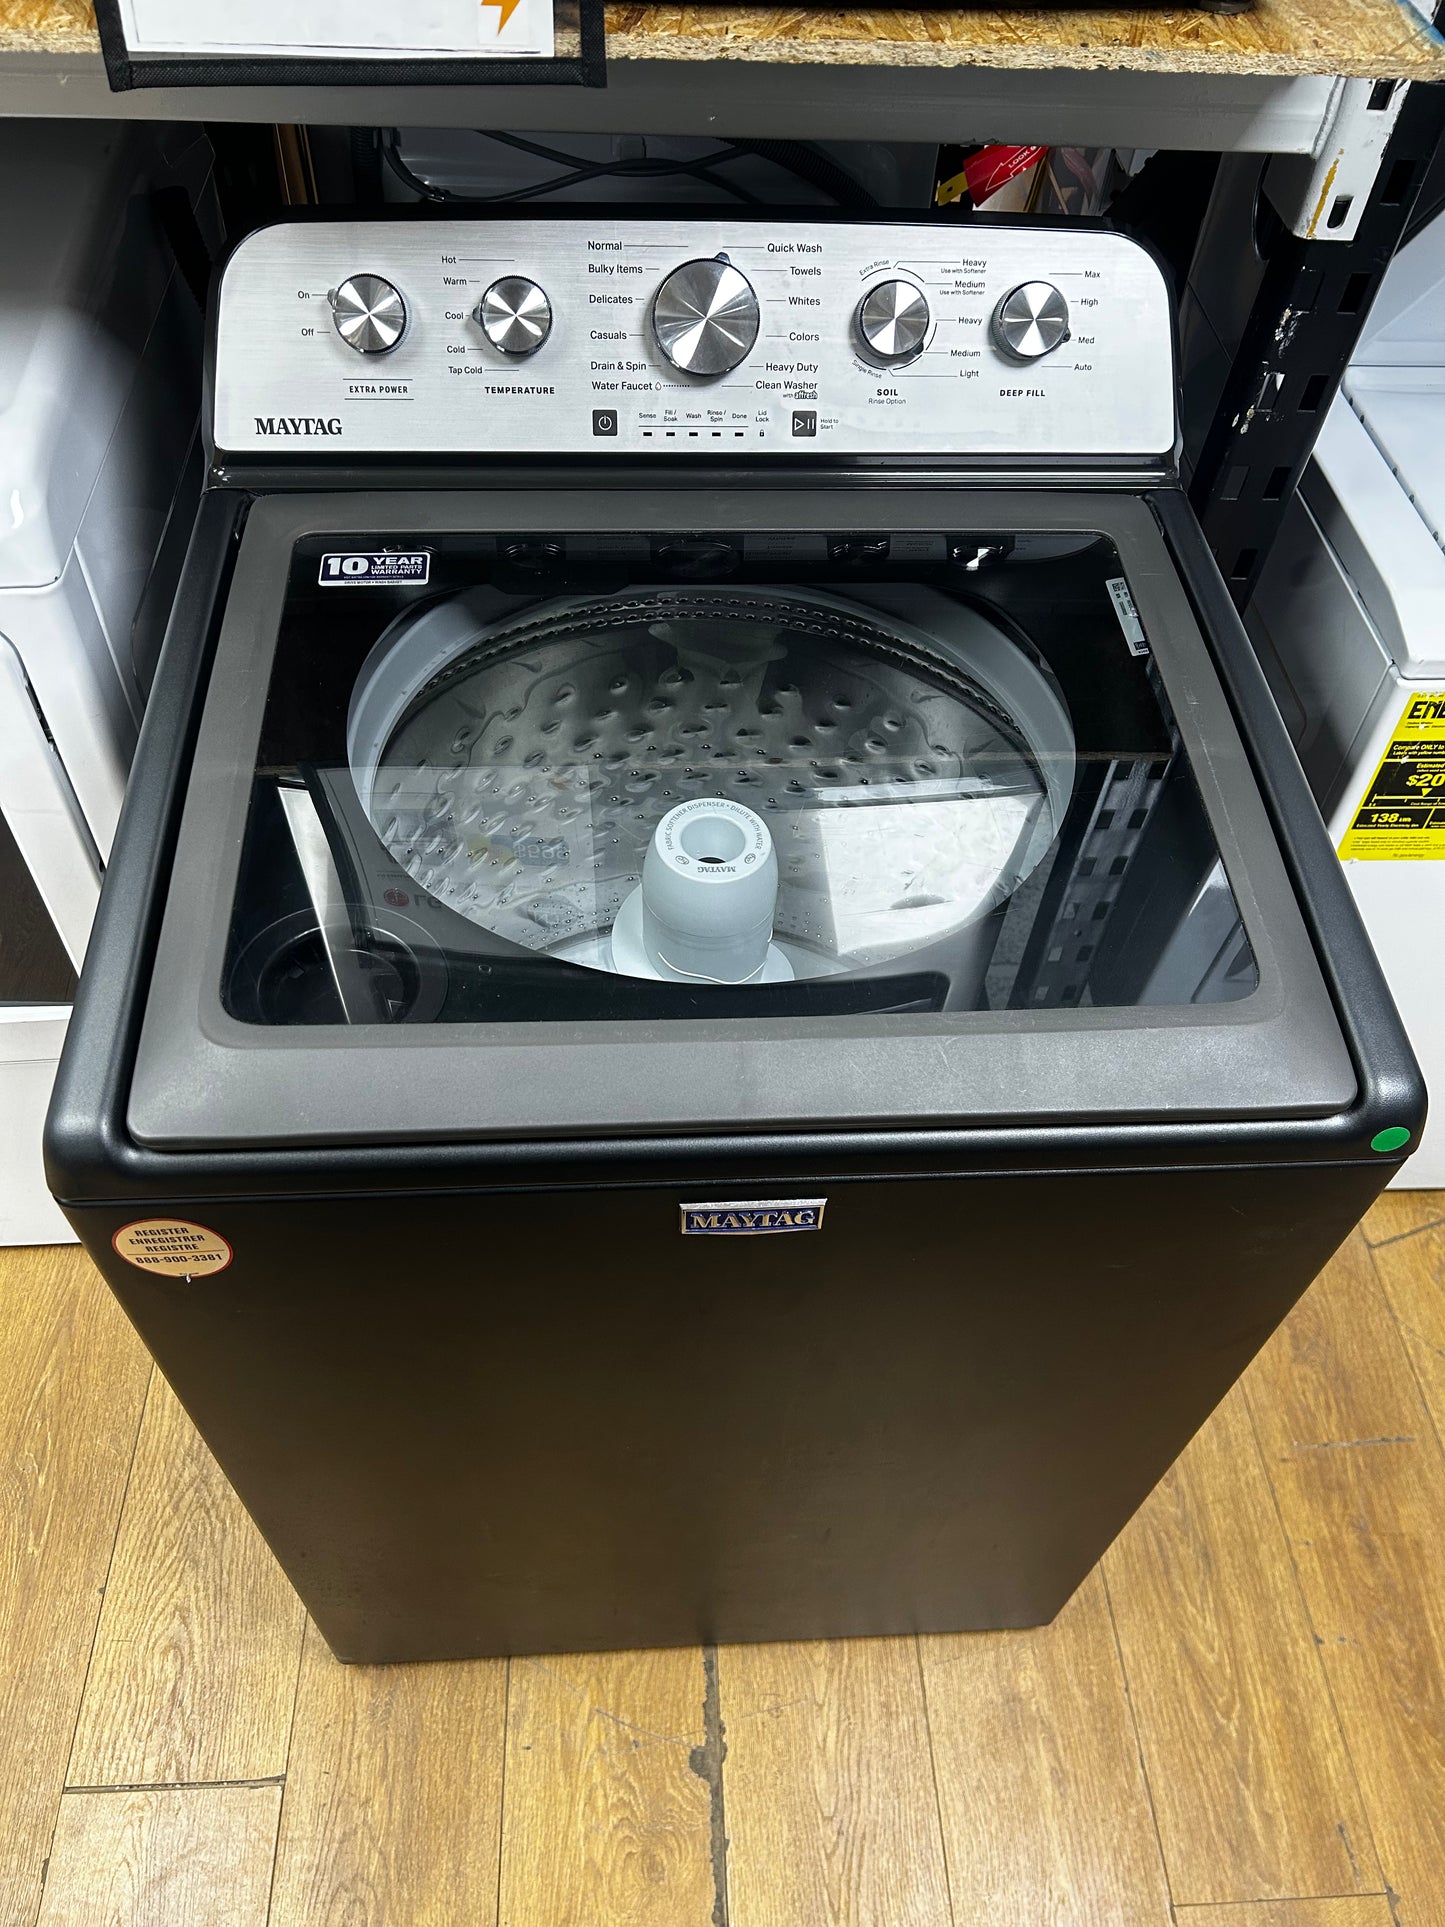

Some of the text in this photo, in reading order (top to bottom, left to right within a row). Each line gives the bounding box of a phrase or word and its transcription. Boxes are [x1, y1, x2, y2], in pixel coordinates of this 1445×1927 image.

[1008, 150, 1030, 168] LOOK
[588, 241, 622, 250] Normal
[767, 244, 822, 252] Quick Wash
[441, 255, 456, 264] Hot
[963, 259, 987, 268] Heavy
[588, 264, 643, 274] Bulky Items
[790, 267, 821, 275] Towels
[443, 277, 467, 286] Warm
[955, 280, 985, 288] Medium
[298, 291, 310, 299] On
[589, 295, 633, 304] Delicates
[788, 297, 821, 306] Whites
[1080, 298, 1099, 307] High
[445, 312, 464, 320] Cool
[959, 316, 983, 326] Heavy
[301, 328, 314, 336] Off
[590, 331, 627, 340] Casuals
[789, 332, 820, 341] Colors
[1078, 336, 1095, 344] Med
[447, 345, 465, 354] Cold
[950, 349, 981, 357] Medium
[448, 366, 482, 376] Tap Cold
[591, 362, 647, 372] Drain & Spin
[766, 363, 818, 373] Heavy Duty
[1074, 363, 1092, 371] Auto
[960, 370, 979, 379] Light
[591, 382, 652, 391] Water Faucet
[755, 381, 818, 389] Clean Washer
[349, 386, 408, 394] EXTRA POWER
[485, 387, 555, 395] TEMPERATURE
[1000, 389, 1046, 397] DEEP FILL
[255, 418, 343, 435] MAYTAG
[328, 557, 423, 575] 10 YEAR
[1371, 813, 1399, 822] 138
[664, 801, 763, 850] FABRIC SOFTENER DISPENSER DILUTE WITH WATER
[690, 1210, 816, 1229] MAYTAG
[135, 1227, 189, 1236] REGISTER
[129, 1235, 205, 1245] ENREGISTRER
[145, 1244, 199, 1252] REGISTRE
[136, 1254, 222, 1263] 888-900-3381
